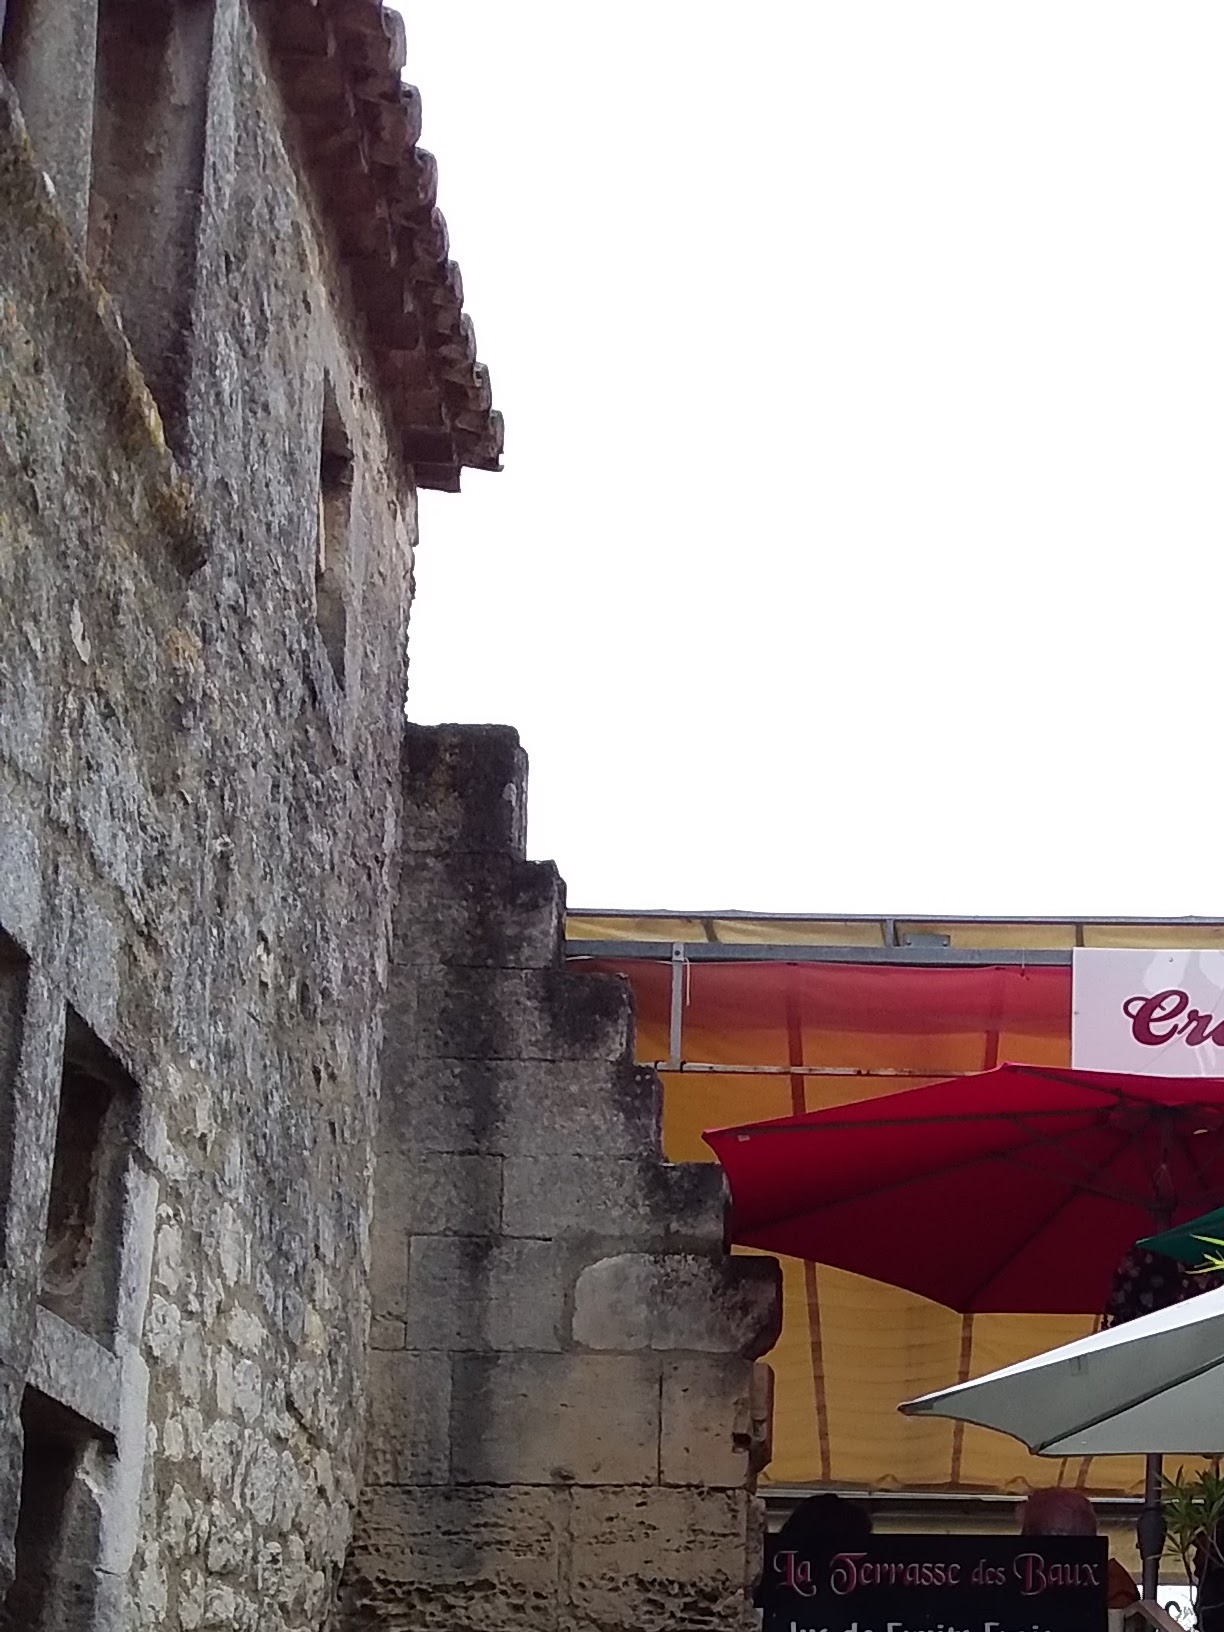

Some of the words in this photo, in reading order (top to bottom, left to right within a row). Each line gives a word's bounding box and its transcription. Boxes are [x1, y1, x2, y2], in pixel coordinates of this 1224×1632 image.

[773, 1550, 817, 1597] La
[829, 1552, 960, 1595] Terrasse
[971, 1559, 1006, 1586] des
[1013, 1552, 1100, 1596] Baux
